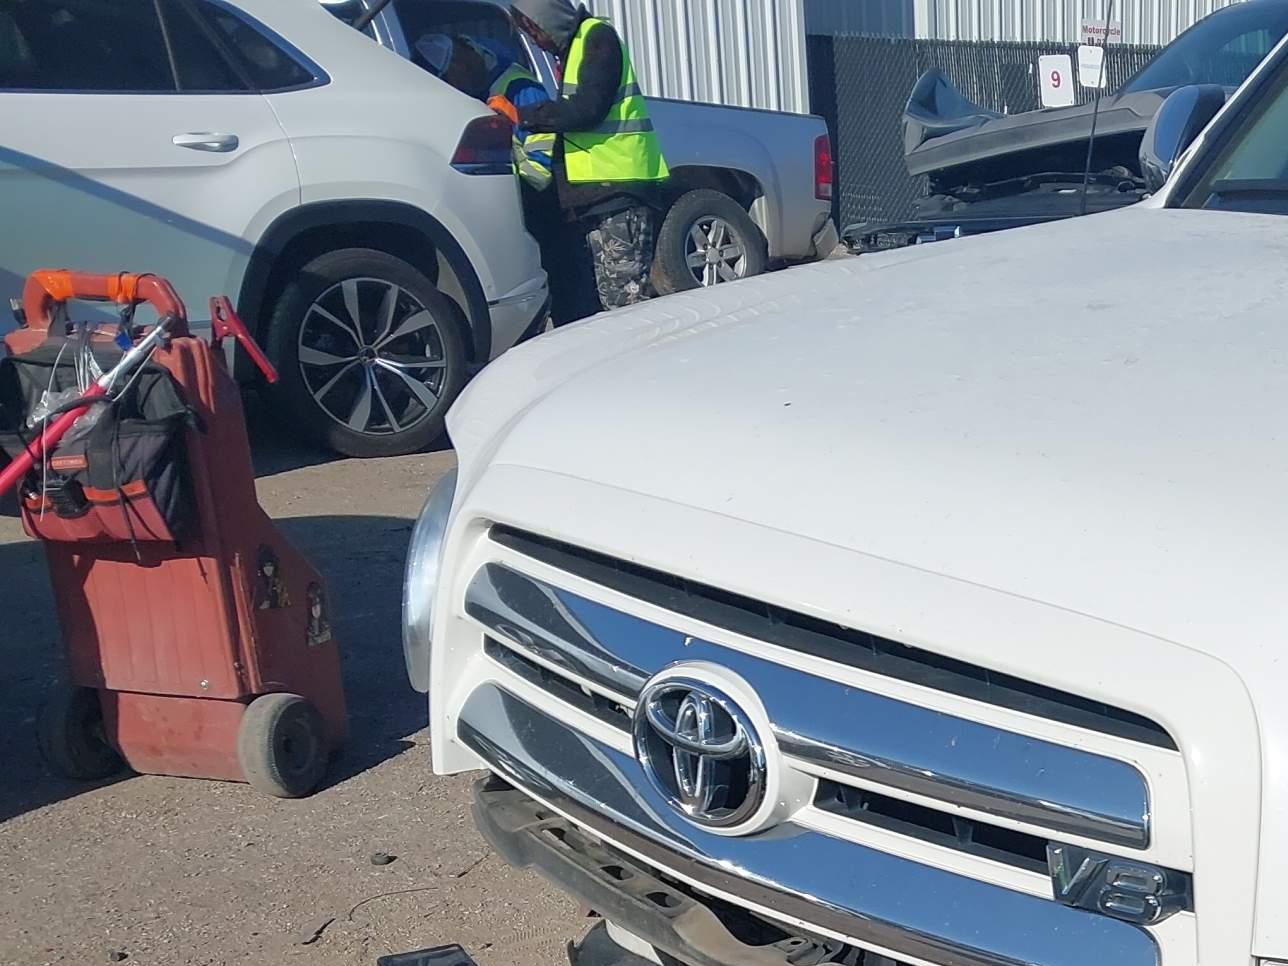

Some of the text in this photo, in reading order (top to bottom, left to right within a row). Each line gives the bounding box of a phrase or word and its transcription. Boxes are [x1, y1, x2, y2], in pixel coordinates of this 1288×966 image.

[1082, 25, 1121, 36] Motorccle
[1051, 70, 1061, 88] 9
[1046, 843, 1167, 925] V8
